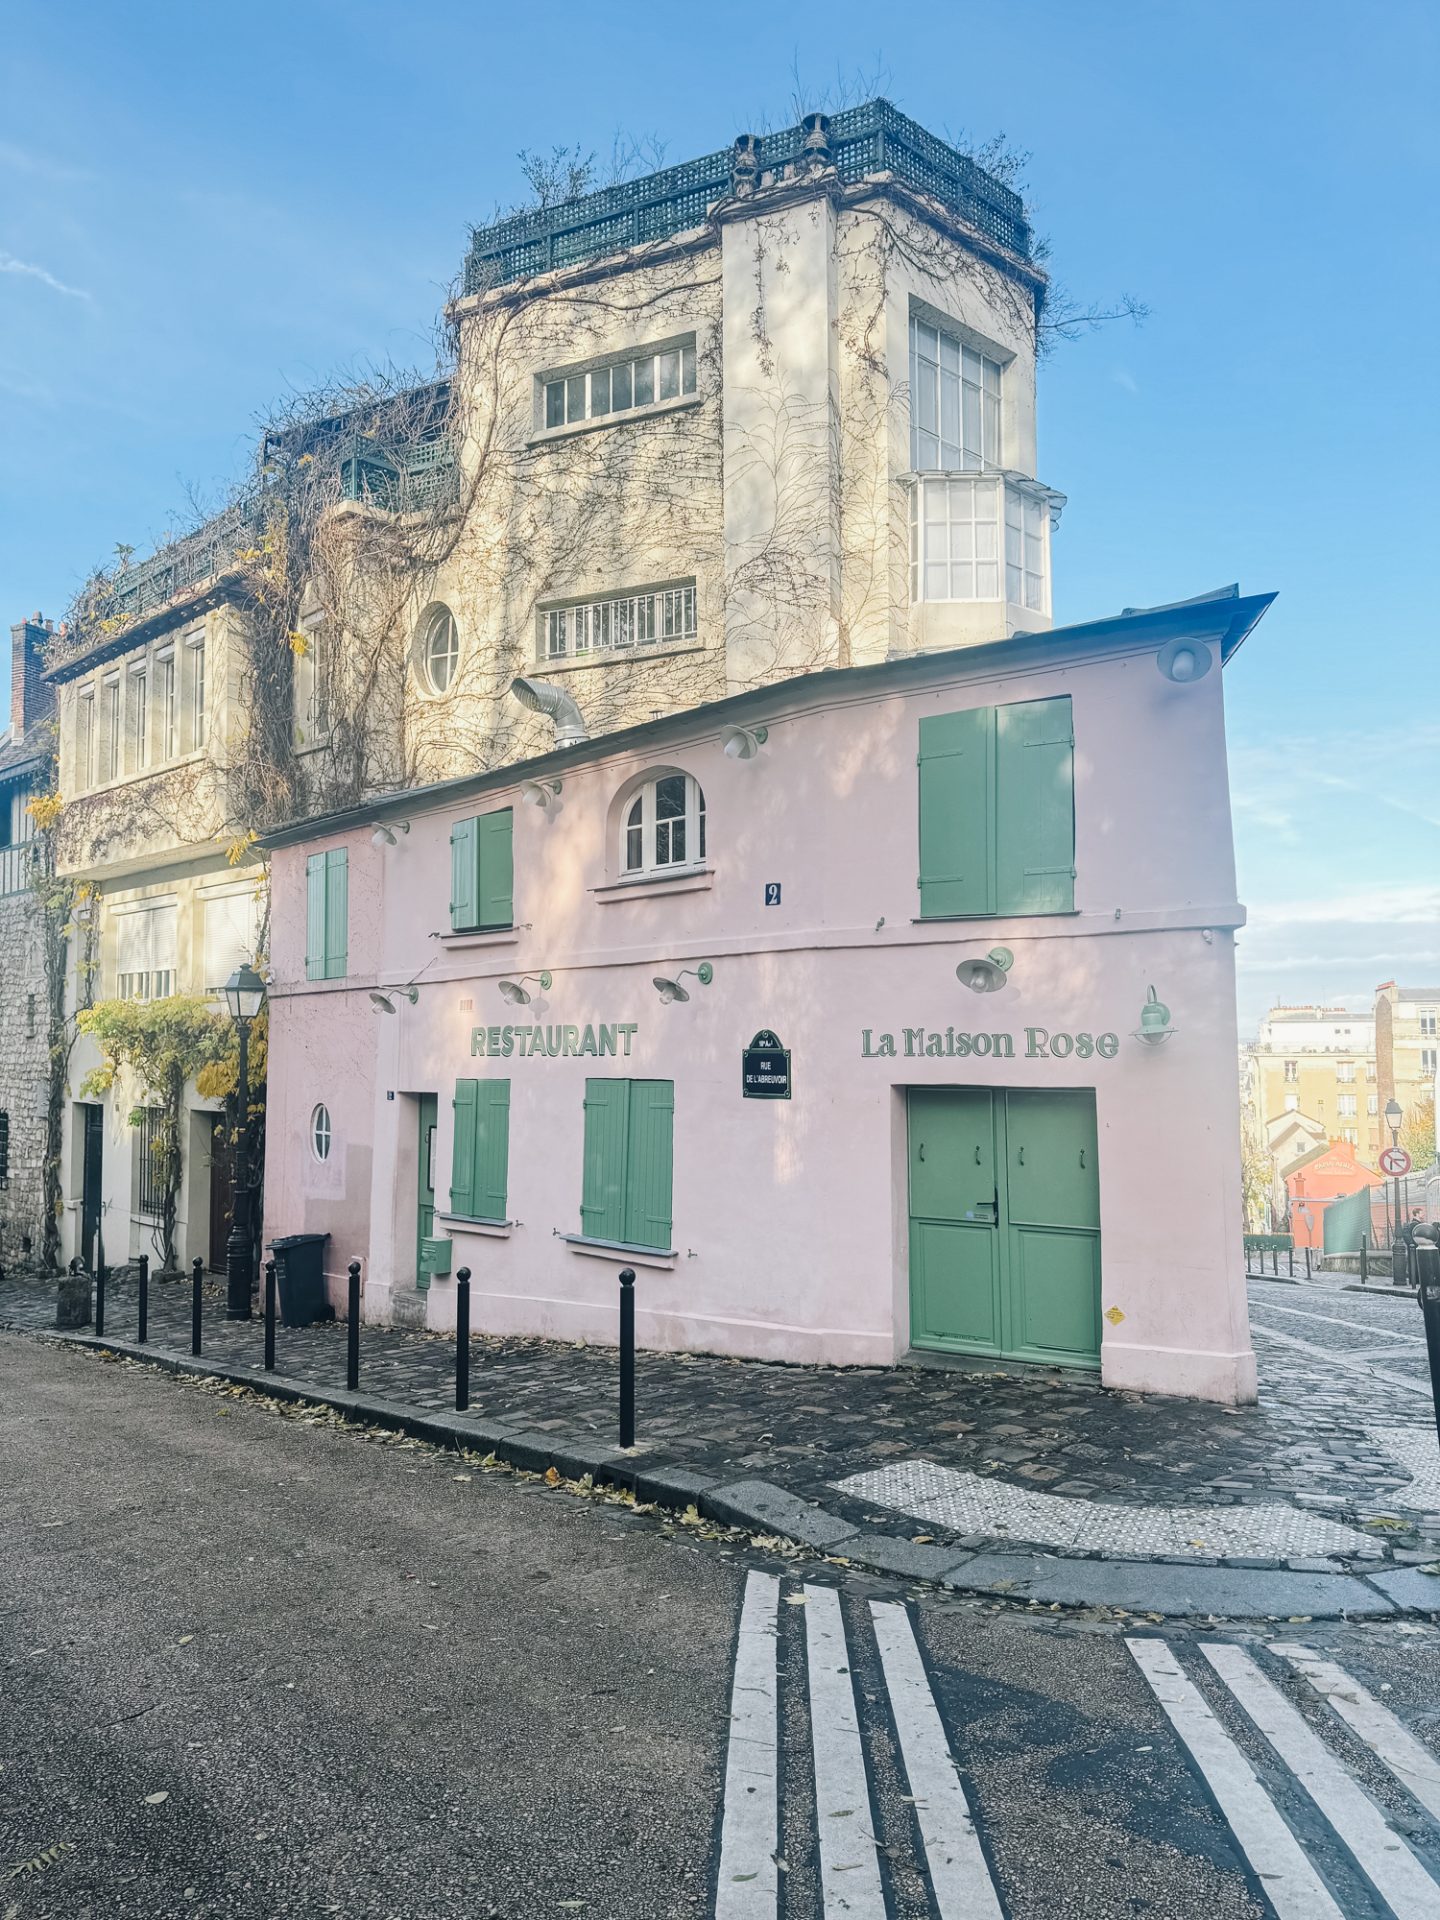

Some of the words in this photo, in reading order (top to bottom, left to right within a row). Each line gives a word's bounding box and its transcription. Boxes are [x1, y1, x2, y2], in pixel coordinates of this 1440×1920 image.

[769, 885, 778, 905] 2
[470, 1023, 638, 1057] RESTAURANT
[861, 1029, 897, 1058] La
[902, 1026, 1016, 1058] Maison
[1024, 1027, 1120, 1058] Rose
[760, 1061, 771, 1070] RUE
[746, 1074, 753, 1083] DE
